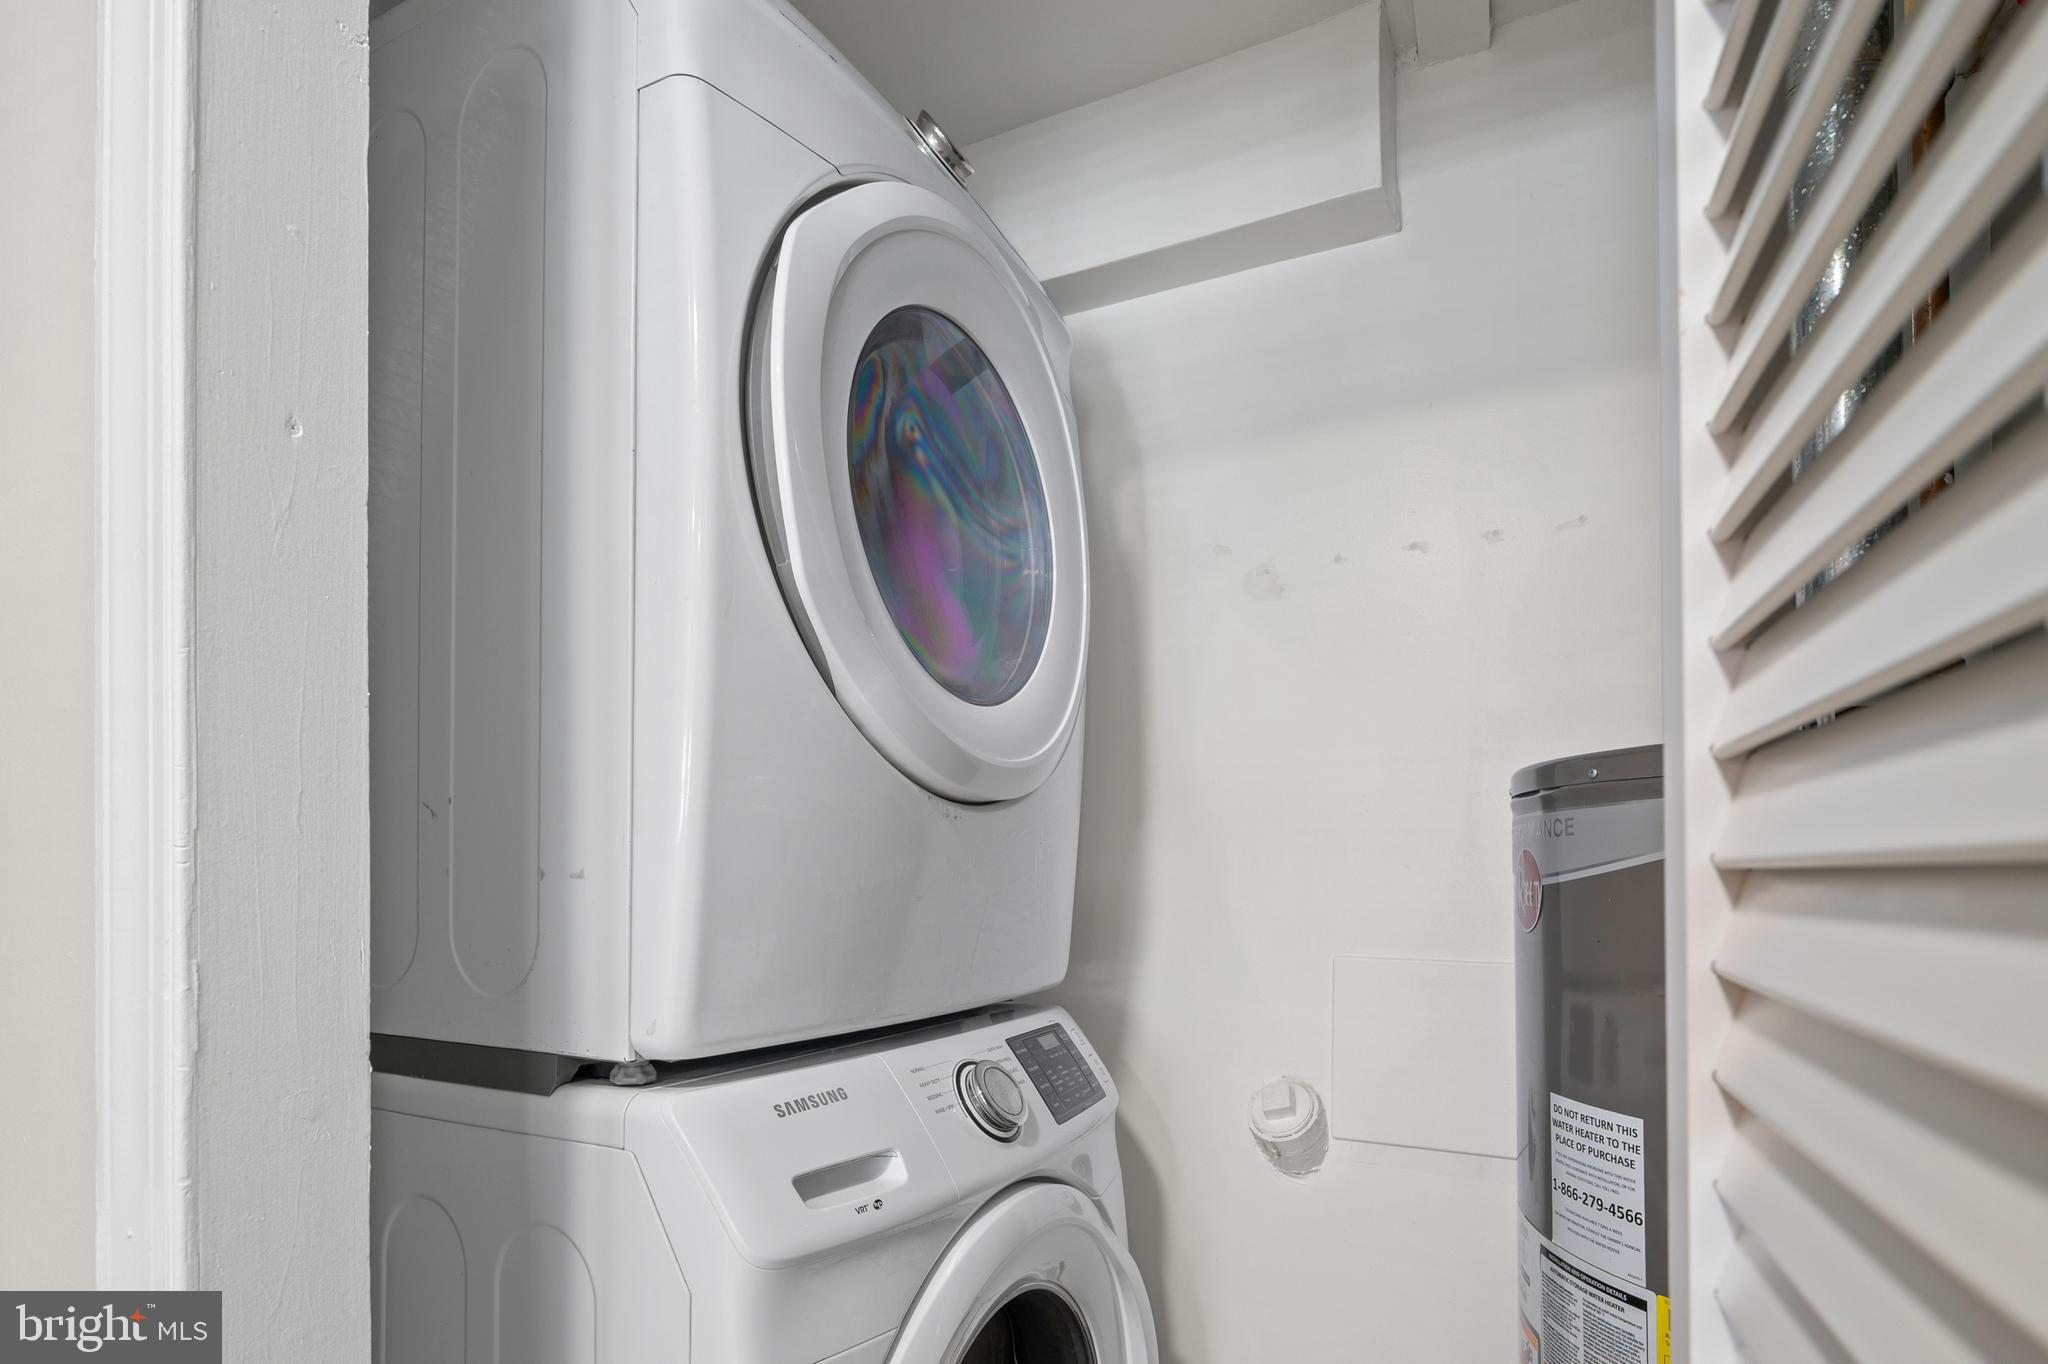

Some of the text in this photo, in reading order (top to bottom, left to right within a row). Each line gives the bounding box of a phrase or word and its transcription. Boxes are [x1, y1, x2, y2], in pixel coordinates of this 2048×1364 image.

[773, 1087, 849, 1118] SAMSUNG
[1552, 1118, 1641, 1155] WATER HEATER TO THE
[1553, 1104, 1638, 1138] DO NOT RETURN THIS
[1555, 1134, 1574, 1149] PLACE
[1576, 1142, 1586, 1153] OF
[1588, 1146, 1636, 1169] PURCHASE
[1553, 1178, 1643, 1226] 1-866-279-4566
[1588, 1291, 1604, 1304] WATER
[1605, 1299, 1625, 1313] HEATER
[1606, 1285, 1627, 1301] DETAILS
